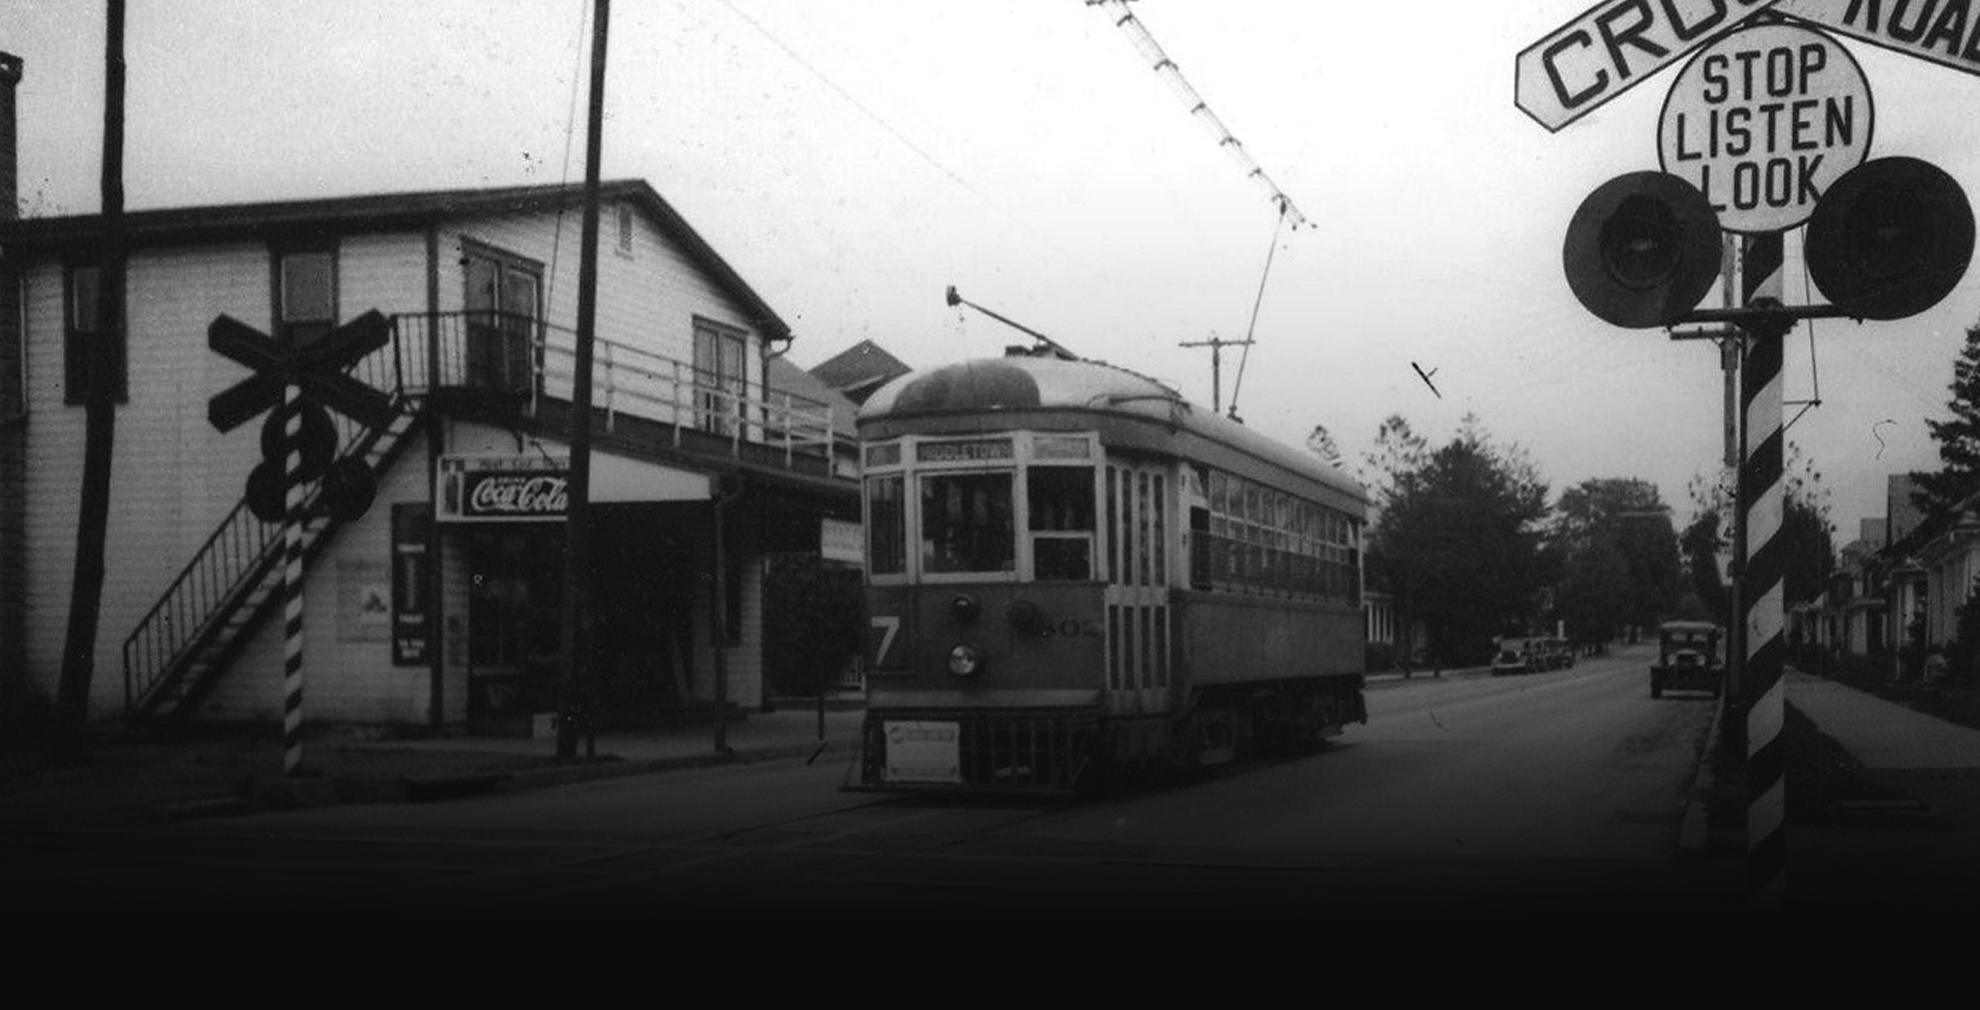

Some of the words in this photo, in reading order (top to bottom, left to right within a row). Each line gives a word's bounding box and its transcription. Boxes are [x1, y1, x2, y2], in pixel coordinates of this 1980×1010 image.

[1542, 0, 1752, 109] CRO
[1702, 43, 1827, 104] STOP
[1676, 95, 1853, 161] LISTEN
[1701, 153, 1824, 213] LOOK
[870, 616, 900, 666] 7
